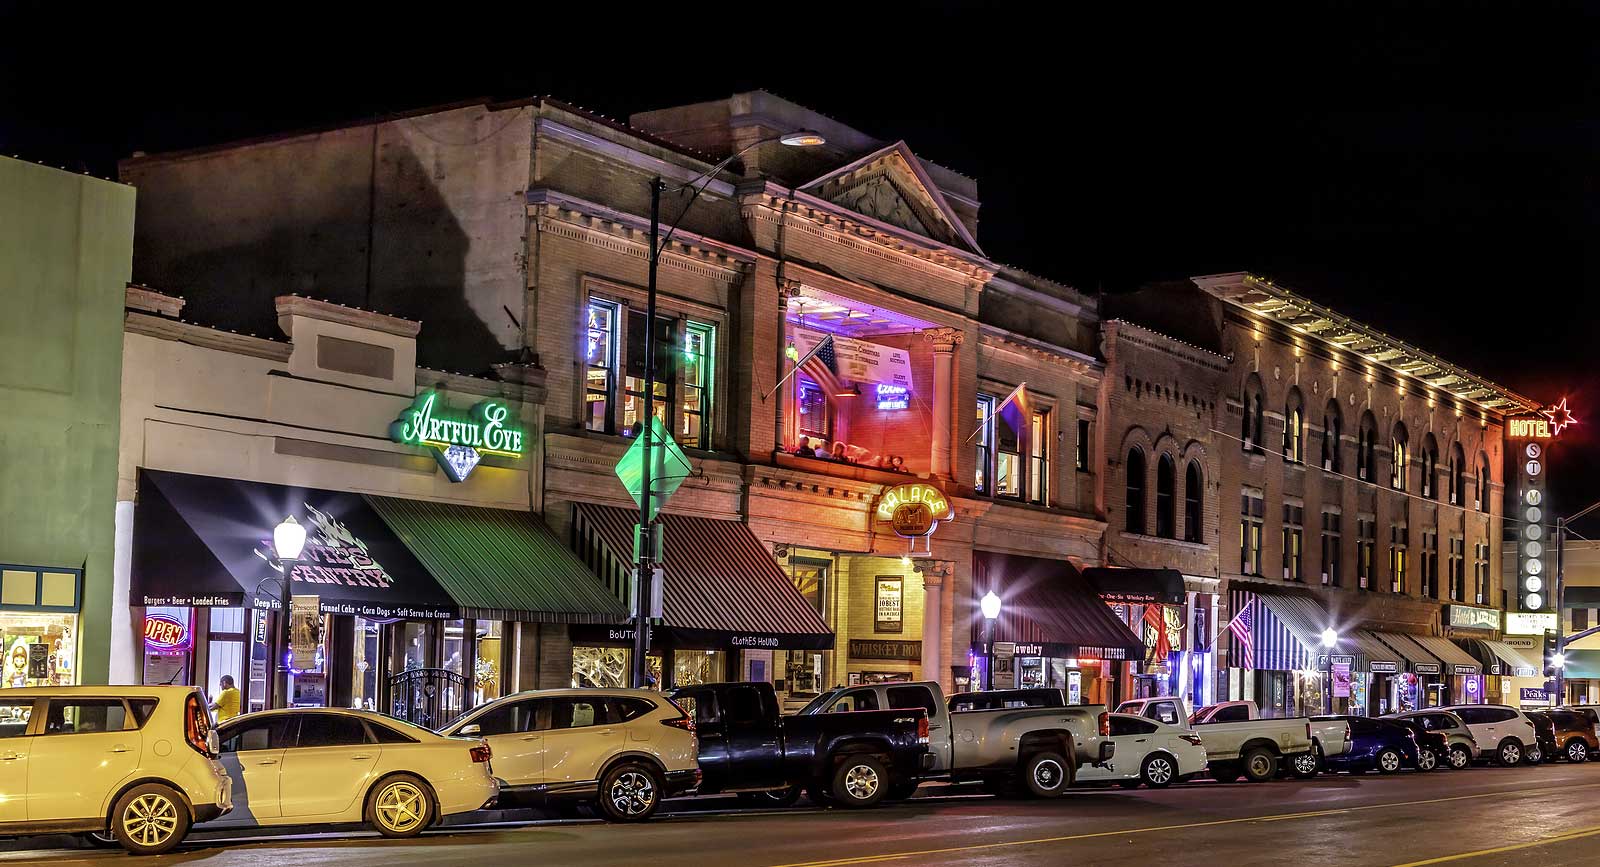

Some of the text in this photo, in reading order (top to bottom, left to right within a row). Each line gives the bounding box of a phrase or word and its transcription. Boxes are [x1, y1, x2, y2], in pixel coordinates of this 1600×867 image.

[1510, 419, 1551, 437] HOTEL
[878, 486, 946, 516] PALACE
[143, 596, 229, 606] Burgers Beer Loaded Fries
[254, 598, 271, 611] Deep
[320, 602, 451, 619] Funnel Cake Corn Dogs Soft Serve Ice Cream
[145, 617, 183, 645] OPEN
[851, 643, 898, 657] WHISKEY
[1523, 688, 1547, 698] Peaks
